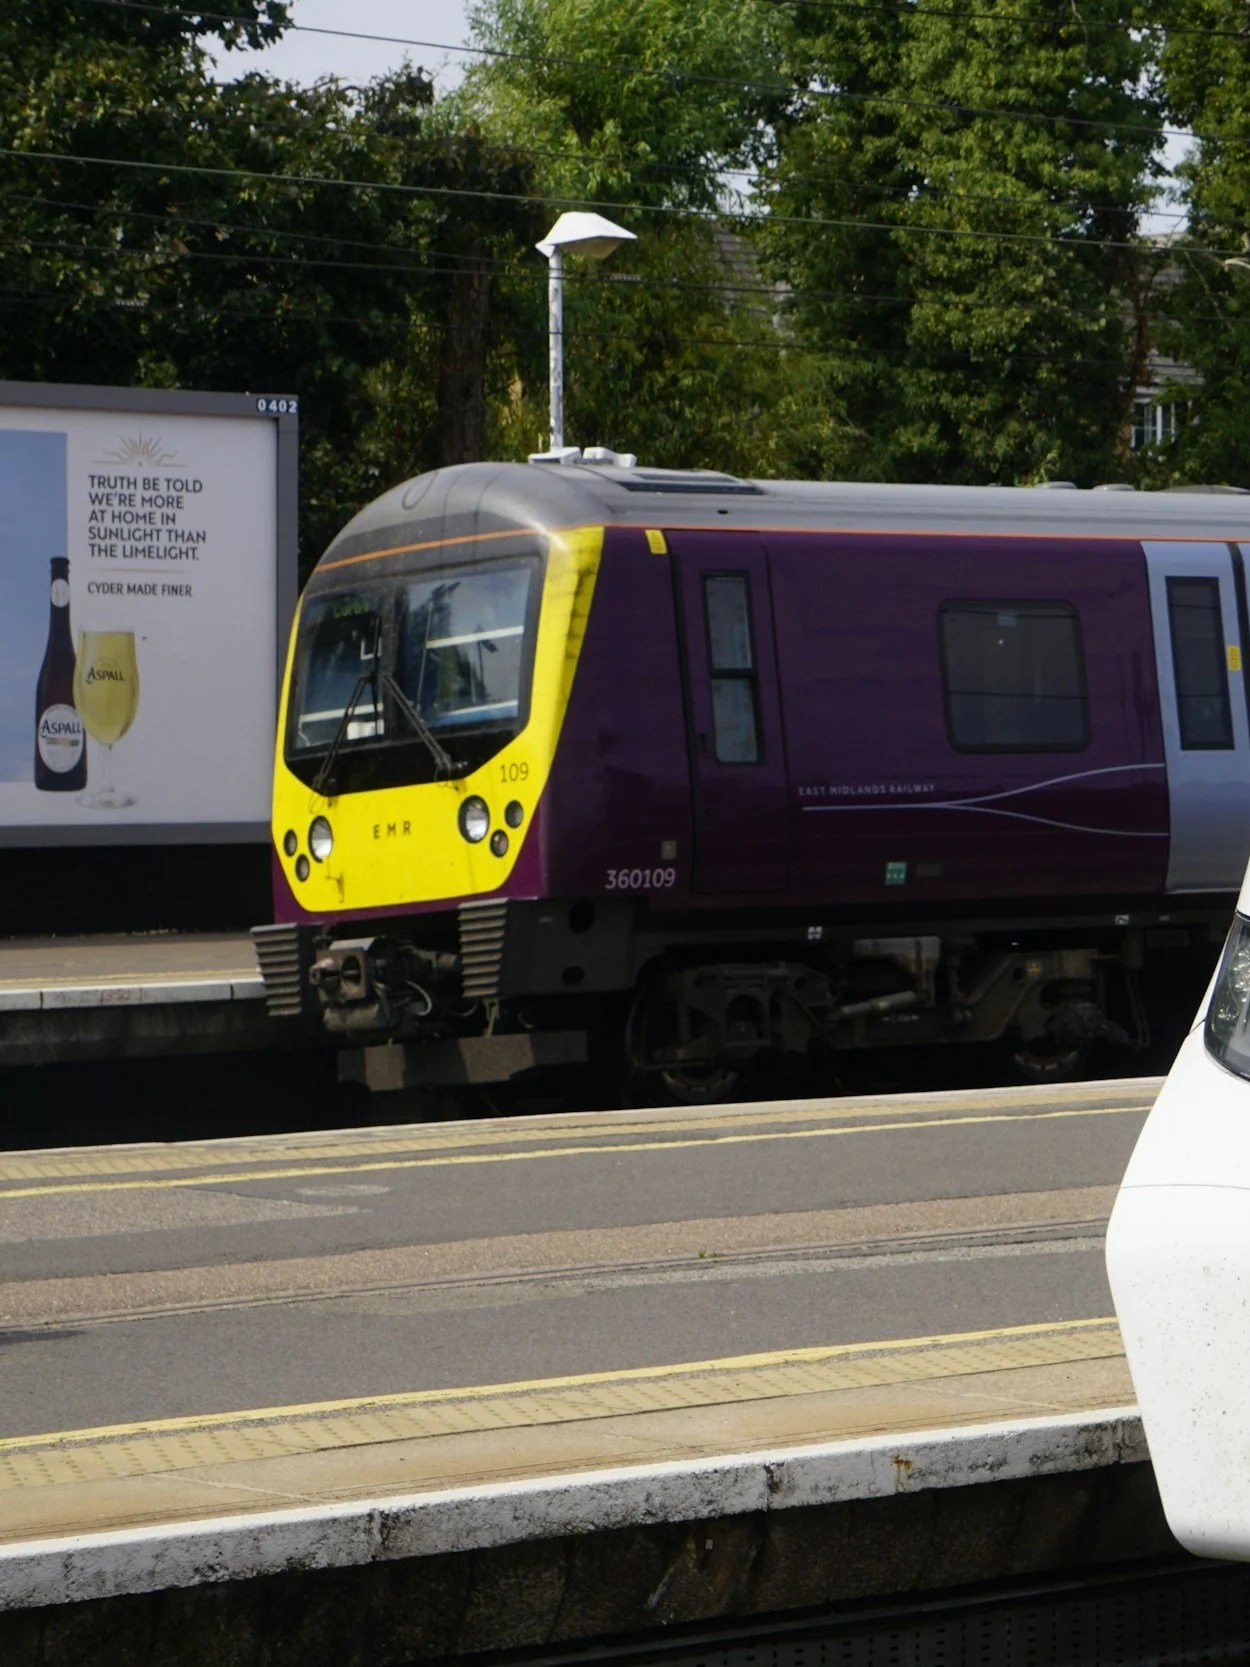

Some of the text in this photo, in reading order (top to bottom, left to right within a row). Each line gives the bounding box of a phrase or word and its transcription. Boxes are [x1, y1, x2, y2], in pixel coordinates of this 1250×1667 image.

[257, 399, 298, 413] 0402
[88, 474, 203, 493] TRUTH BE TOLD
[141, 494, 185, 509] MORE
[88, 509, 176, 526] AT HOME IN
[88, 527, 206, 544] SUNLIGHT THAN
[89, 543, 199, 561] THE LIMELIGHT.
[87, 582, 192, 597] CYDER MADE FINER
[500, 762, 529, 783] 109
[798, 783, 935, 796] EAST MIDLANDS RAILWAY
[605, 868, 676, 890] 360109
